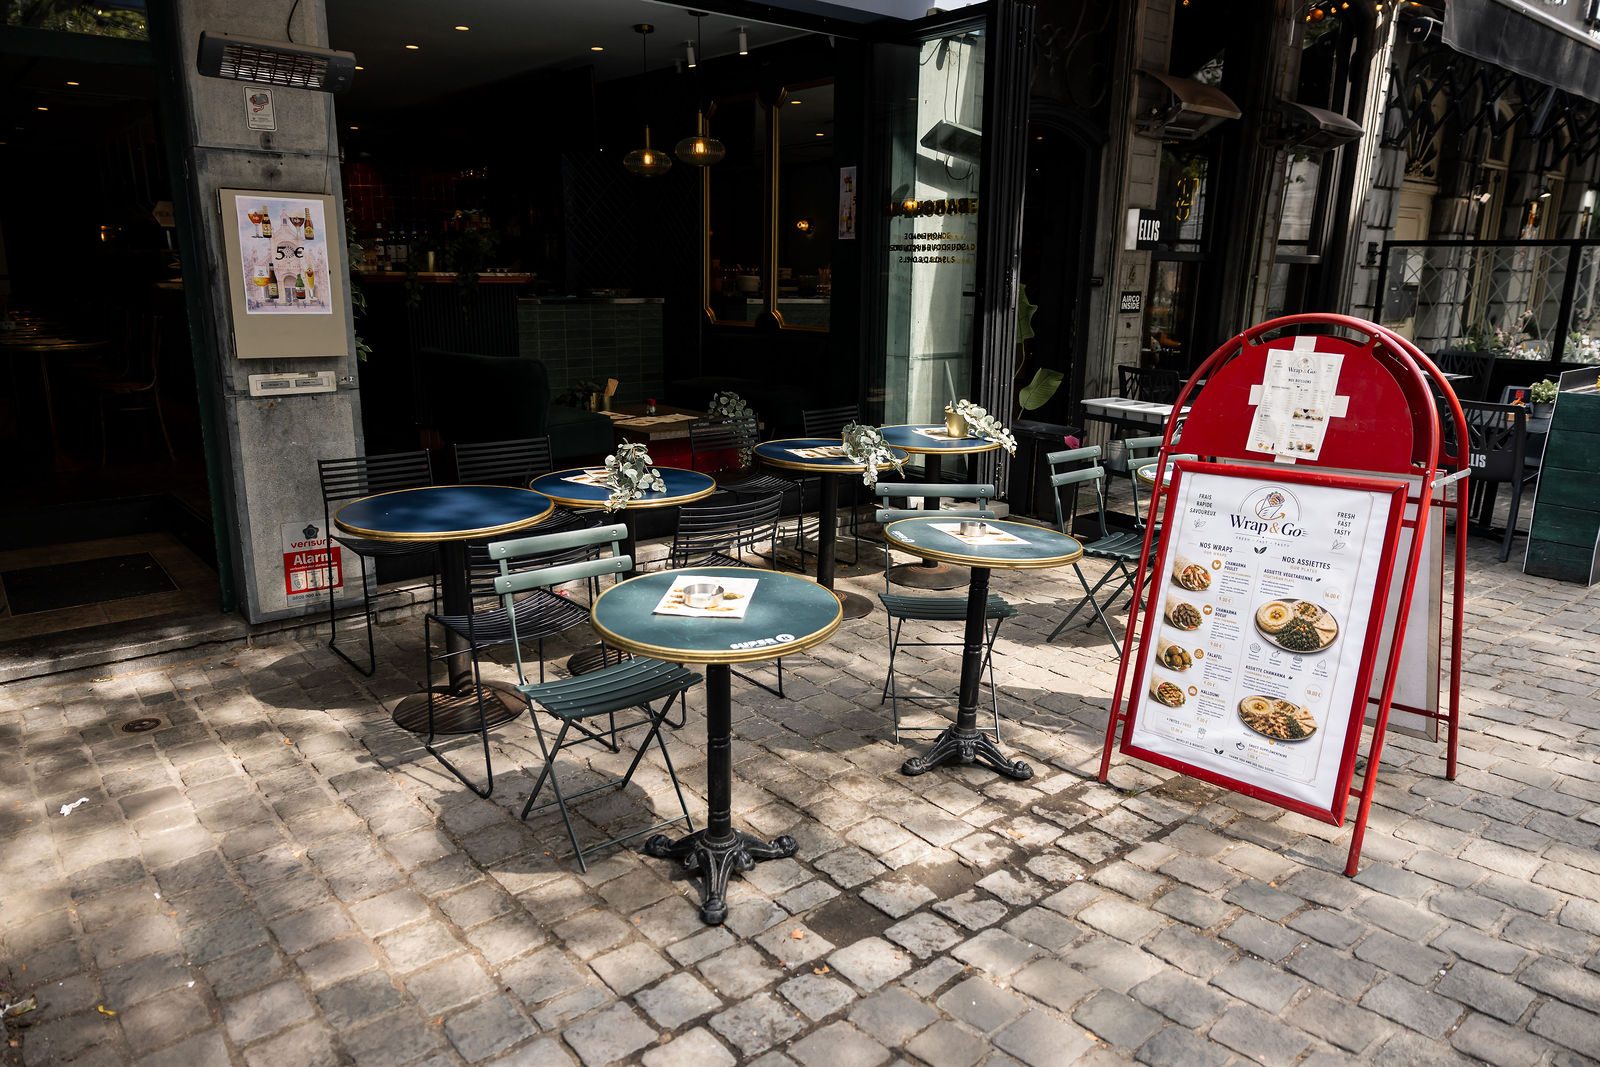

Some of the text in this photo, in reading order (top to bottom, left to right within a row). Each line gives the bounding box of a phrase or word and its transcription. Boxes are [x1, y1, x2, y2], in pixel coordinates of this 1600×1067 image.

[1138, 219, 1160, 242] ELLIS
[275, 246, 305, 260] 5 €
[1470, 453, 1486, 468] LIS
[1190, 508, 1216, 516] SAVOUREUX
[1230, 514, 1302, 538] Wrap & Go
[1212, 543, 1233, 553] WRAPS
[1297, 558, 1331, 569] ASSIETTES
